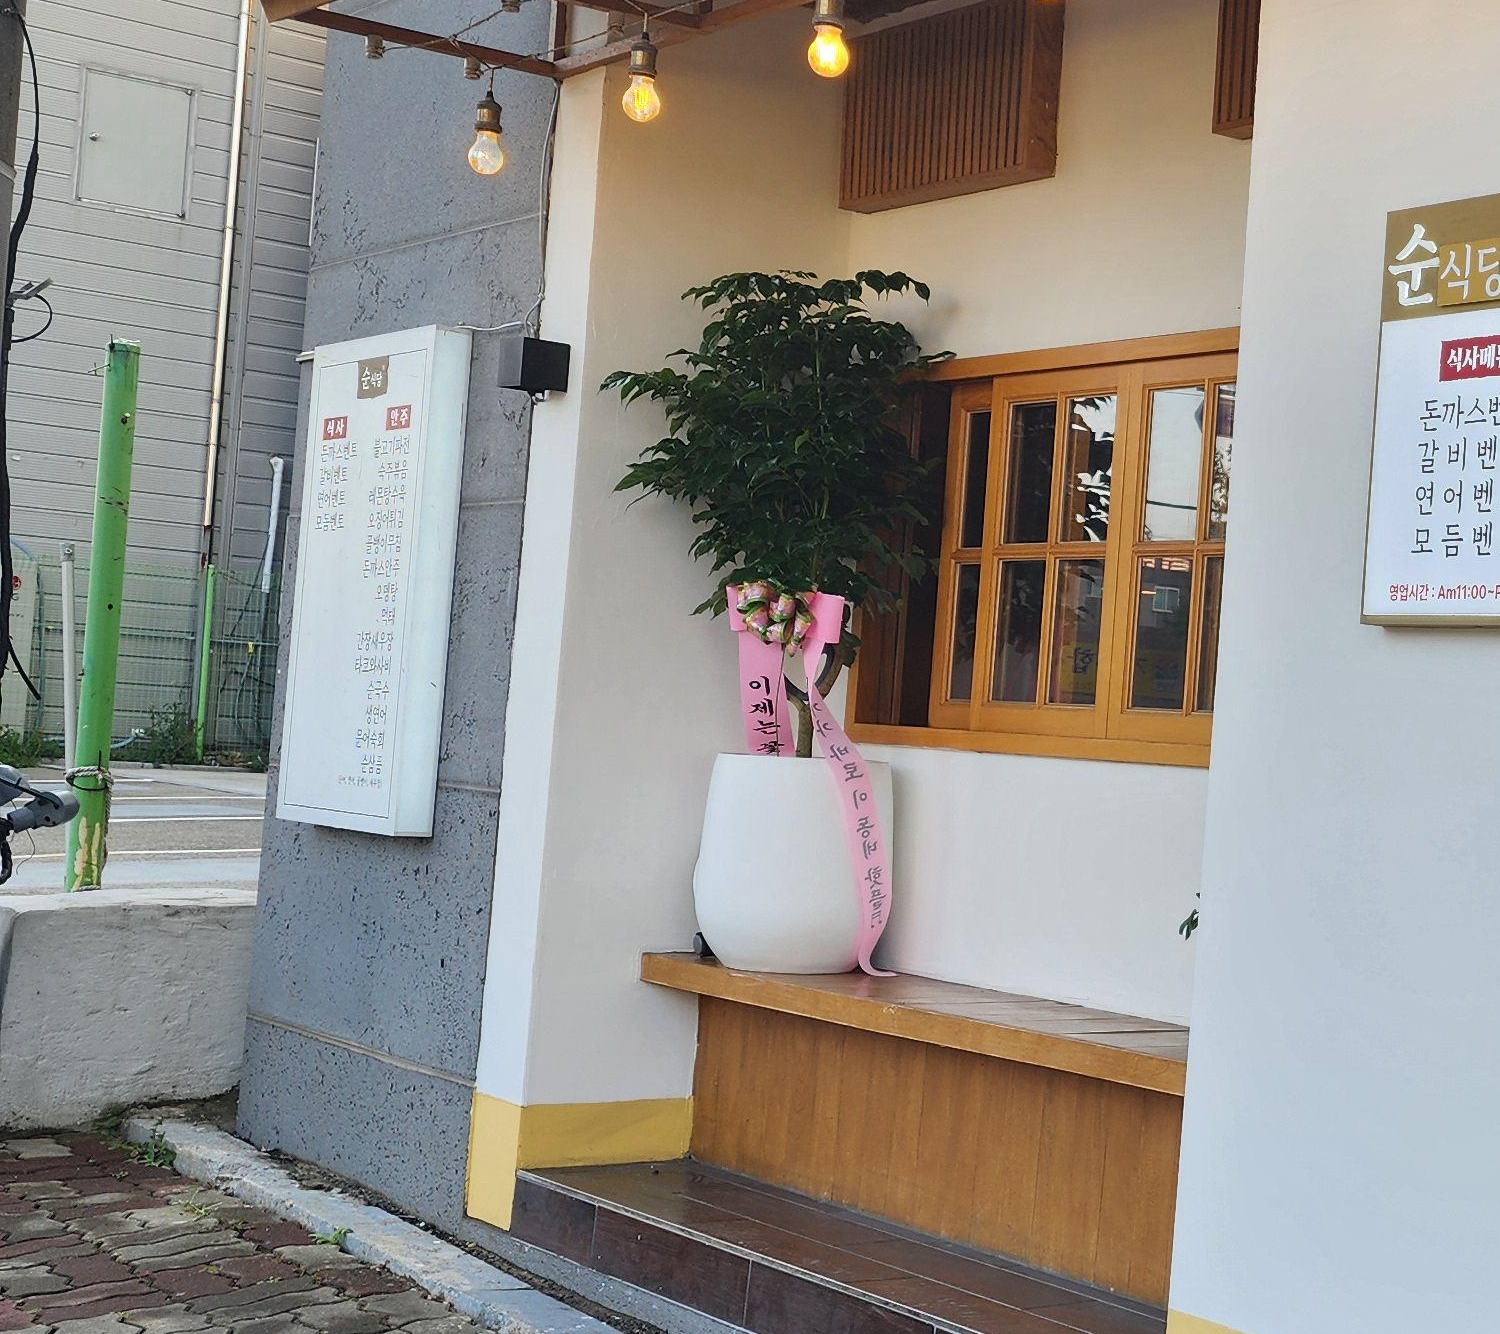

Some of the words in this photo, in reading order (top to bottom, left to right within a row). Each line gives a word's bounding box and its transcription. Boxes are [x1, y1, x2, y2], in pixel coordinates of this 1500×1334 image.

[361, 366, 383, 390] 순식당
[326, 418, 345, 437] 식사
[390, 407, 409, 427] 안주
[320, 441, 358, 463] 돈까스벤토
[373, 434, 411, 459] 불고기파전
[319, 465, 348, 486] 갈비벤토
[377, 459, 409, 481] 숙주볶음
[317, 487, 346, 509] 연어벤토
[368, 484, 407, 507] 레몬탕수육
[314, 512, 345, 532] 모듬벤토
[367, 508, 405, 530] 오징어튀김
[365, 533, 402, 555] 골뱅이무침
[362, 557, 401, 579] 돈까스안주
[374, 581, 399, 603] 오뎅탕
[1389, 583, 1430, 602] 영업시간
[381, 606, 396, 626] 먹태
[357, 630, 394, 652] 간장새우장
[366, 680, 390, 701] 순국수
[365, 704, 388, 726] 생연어
[748, 675, 782, 735] 이제는
[355, 728, 386, 750] 문어숙회
